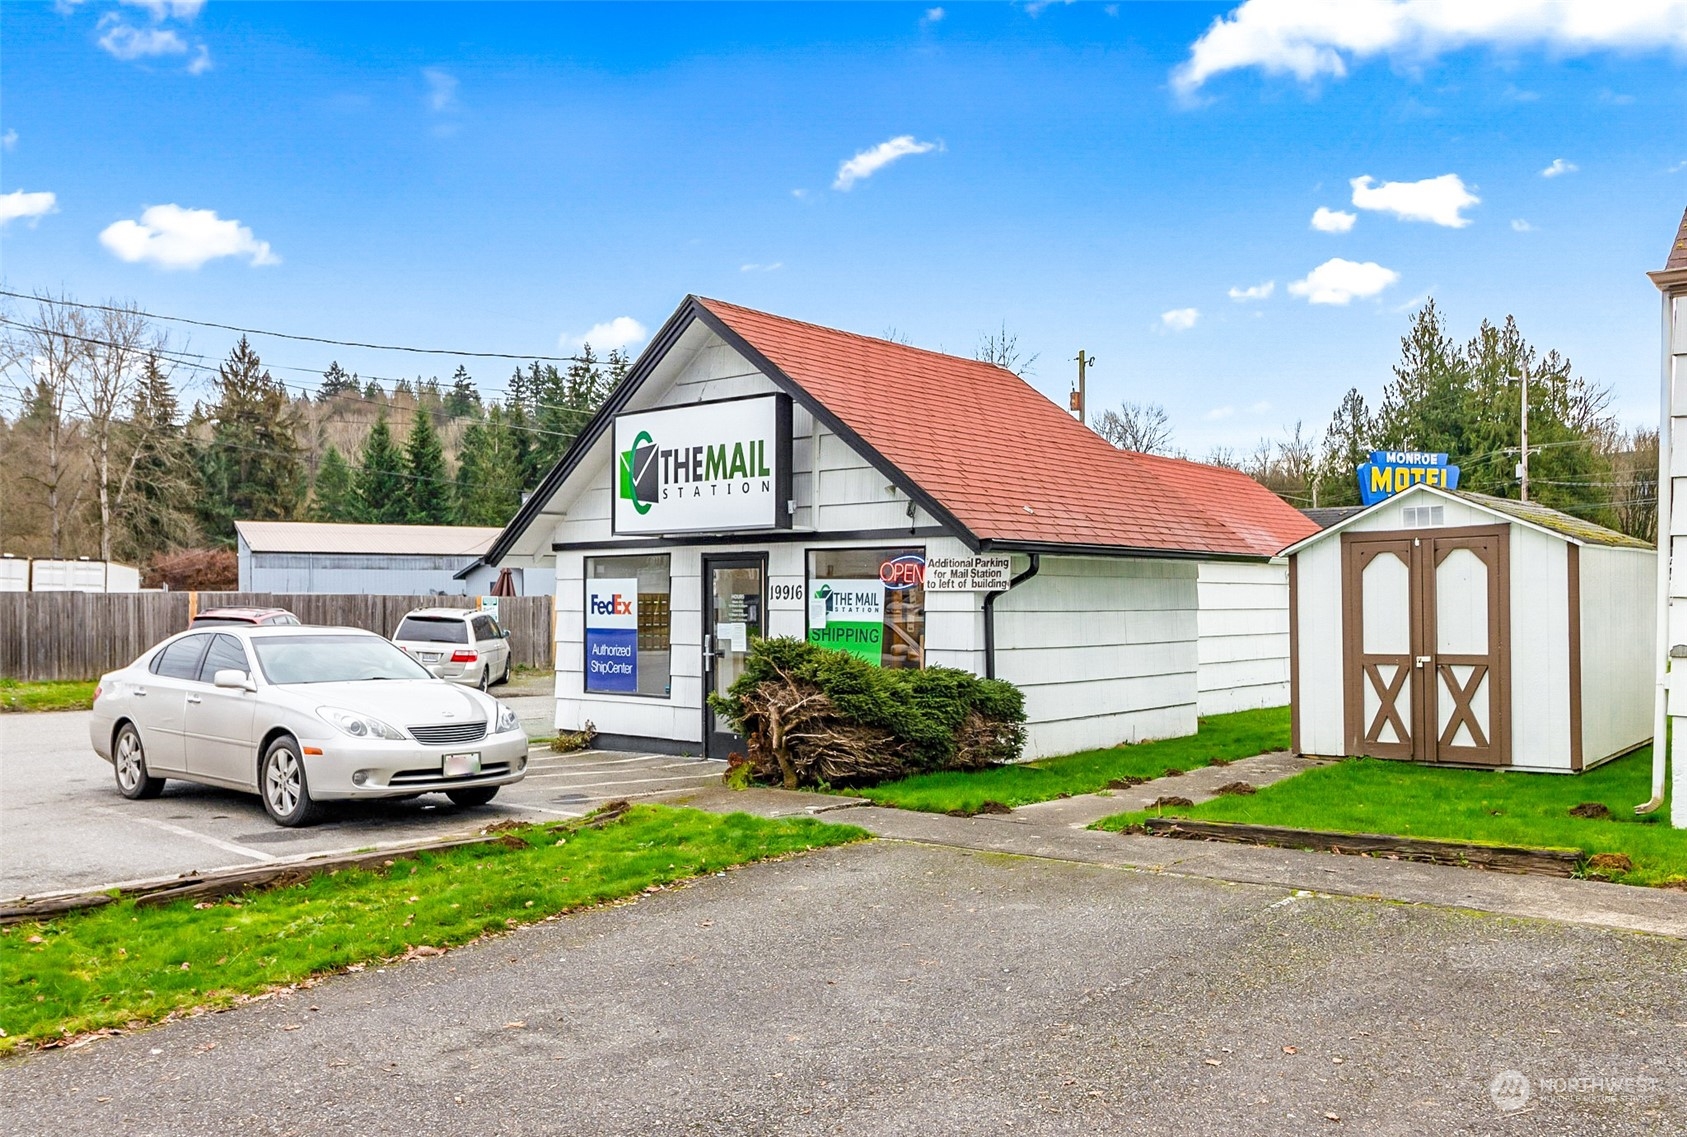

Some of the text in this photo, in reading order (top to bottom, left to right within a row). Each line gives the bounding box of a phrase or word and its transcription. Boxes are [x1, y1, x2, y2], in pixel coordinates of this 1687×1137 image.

[1386, 452, 1438, 465] MONROE
[662, 480, 770, 500] STATION
[928, 558, 1009, 569] Additional Parking
[879, 561, 925, 583] OPEN
[933, 568, 1002, 578] for Mail Station
[769, 584, 803, 600] 19916
[927, 579, 1008, 590] to left of building
[590, 594, 632, 615] FedEx
[833, 592, 879, 606] THE MAIL
[811, 627, 879, 643] SHIPPING
[591, 643, 631, 657] Authorized
[590, 659, 633, 675] ShipCenter
